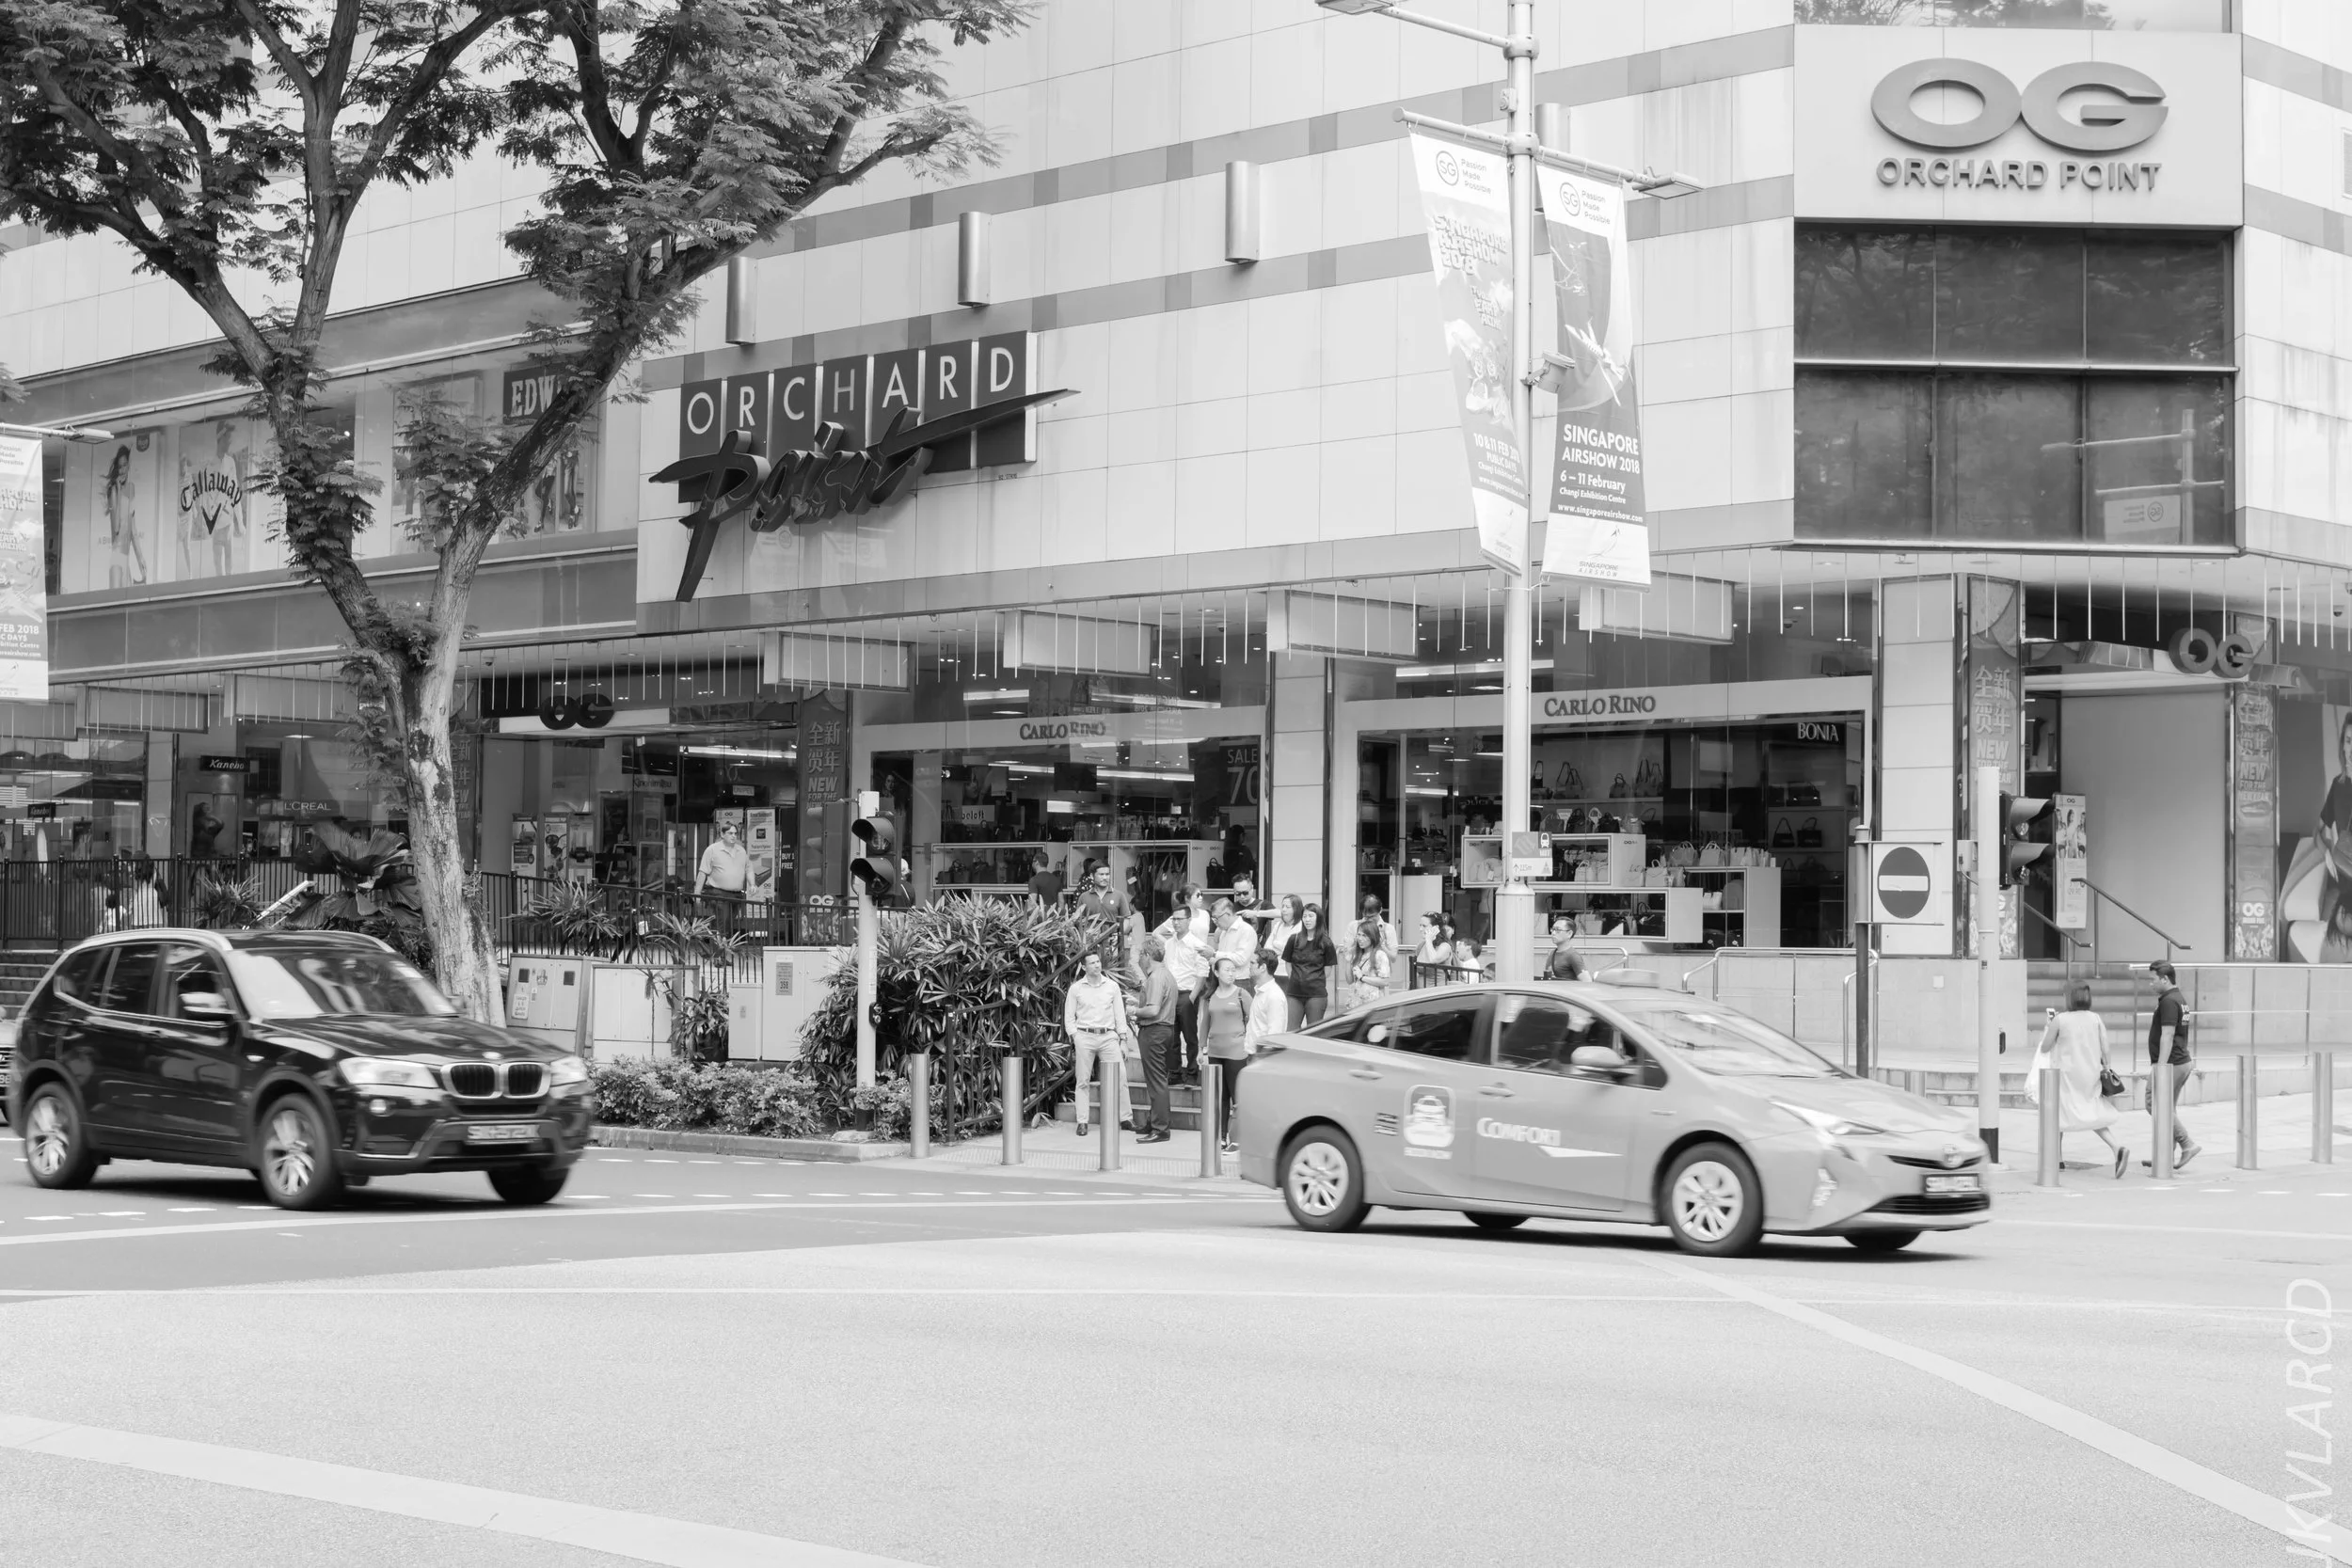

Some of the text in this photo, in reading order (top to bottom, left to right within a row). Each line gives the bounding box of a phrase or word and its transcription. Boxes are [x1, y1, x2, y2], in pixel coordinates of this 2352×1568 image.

[1871, 57, 2169, 151] OG
[1438, 159, 1456, 177] SG
[1460, 158, 1487, 172] Passion
[1876, 157, 2162, 191] ORCHARD POINT
[1462, 169, 1481, 181] Made
[1563, 191, 1579, 208] SG
[1581, 190, 1606, 203] Passion
[1582, 200, 1600, 212] Made
[687, 346, 1014, 436] ORCHARD
[1497, 440, 1510, 457] FEB
[1563, 423, 1639, 455] SINGAPORE
[1562, 446, 1640, 474] AIRSHOW 2018
[181, 467, 243, 512] Callaway
[1560, 470, 1566, 482] 6
[1578, 472, 1586, 485] 11
[1587, 474, 1626, 495] February
[1559, 487, 1626, 504] Changi Exhibition Centre
[1558, 504, 1644, 523] www.singaporeairshow.com
[17, 625, 40, 634] 2018
[2168, 627, 2254, 678] OG
[539, 693, 614, 731] OG
[1544, 694, 1656, 717] CARLO RINO
[808, 721, 841, 746] 全新
[1020, 721, 1106, 740] CARLO RINO
[1798, 722, 1839, 742] BONIA
[1228, 749, 1258, 764] SALE
[1977, 738, 2010, 760] NEW
[209, 759, 245, 769] Kanebo
[807, 748, 841, 773] 贺年
[2240, 762, 2267, 780] NEW
[808, 777, 838, 792] NEW
[807, 792, 837, 801] FOR THE
[809, 895, 834, 907] OG
[2242, 902, 2265, 917] OG
[1476, 1117, 1561, 1147] COMFORT
